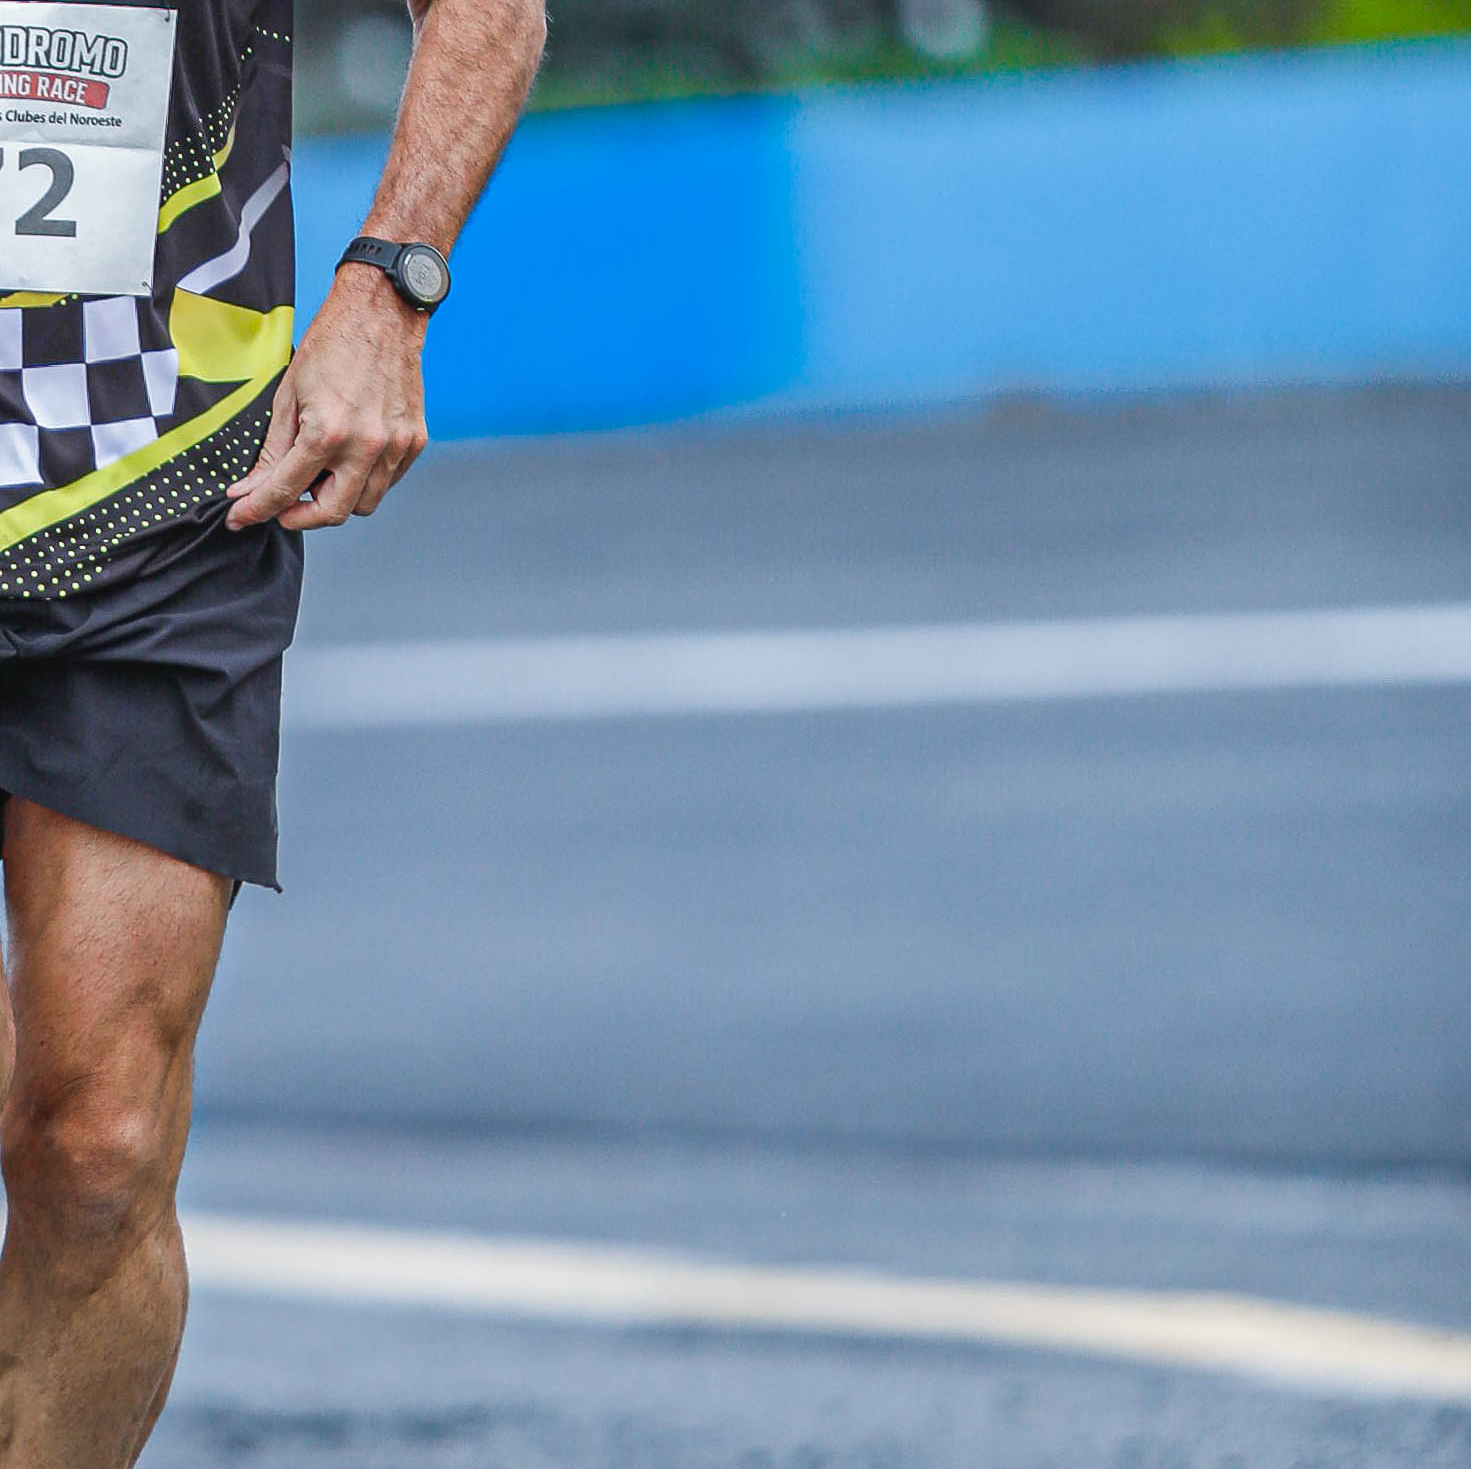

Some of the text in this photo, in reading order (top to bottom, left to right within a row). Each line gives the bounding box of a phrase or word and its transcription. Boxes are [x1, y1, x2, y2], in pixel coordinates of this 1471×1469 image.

[37, 76, 88, 104] RACE
[6, 110, 45, 123] Clubes
[48, 112, 66, 124] del
[70, 114, 122, 127] Noroeste
